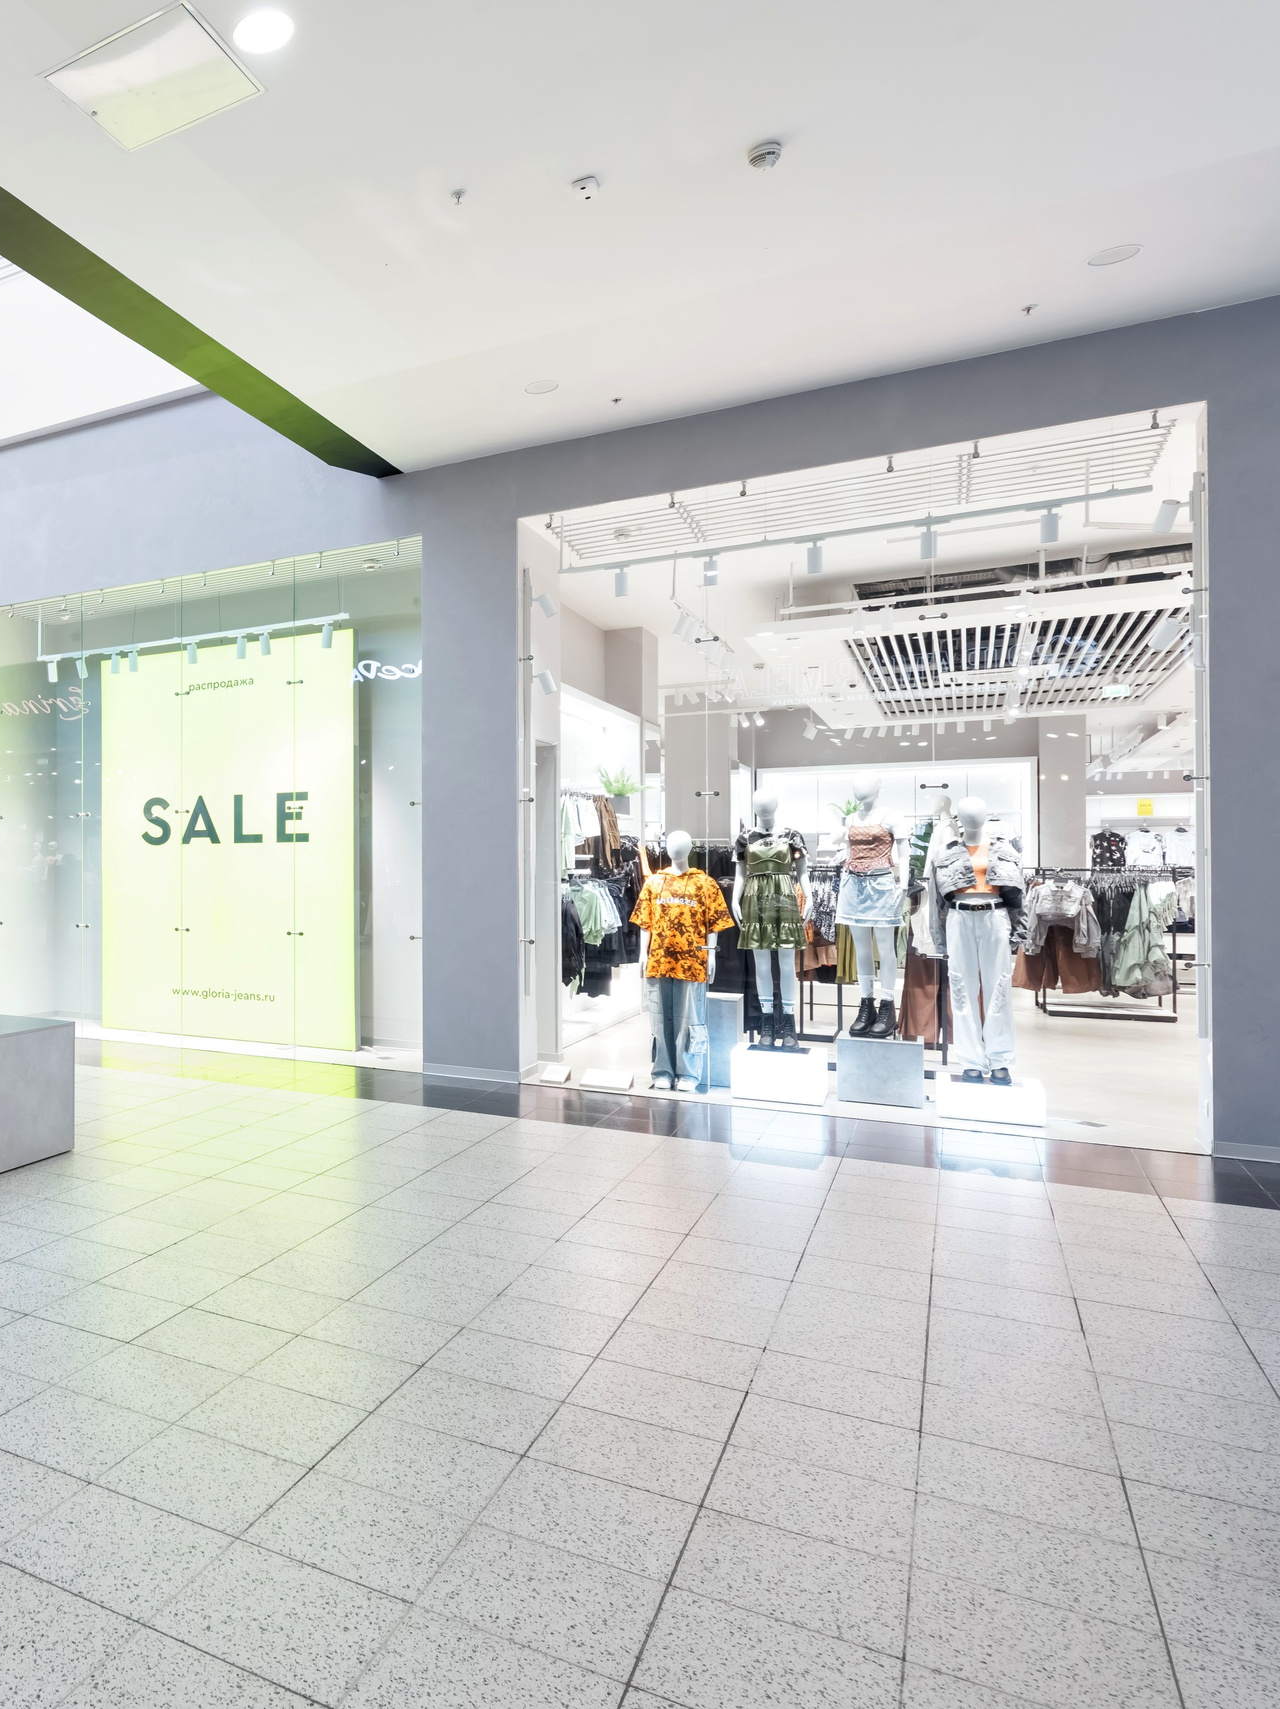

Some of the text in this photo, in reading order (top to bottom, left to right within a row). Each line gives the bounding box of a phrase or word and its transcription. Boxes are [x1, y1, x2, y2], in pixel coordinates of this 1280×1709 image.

[188, 677, 254, 693] распродажа
[141, 791, 310, 846] SALE
[172, 987, 275, 1002] www.gloria-jeans.ru
